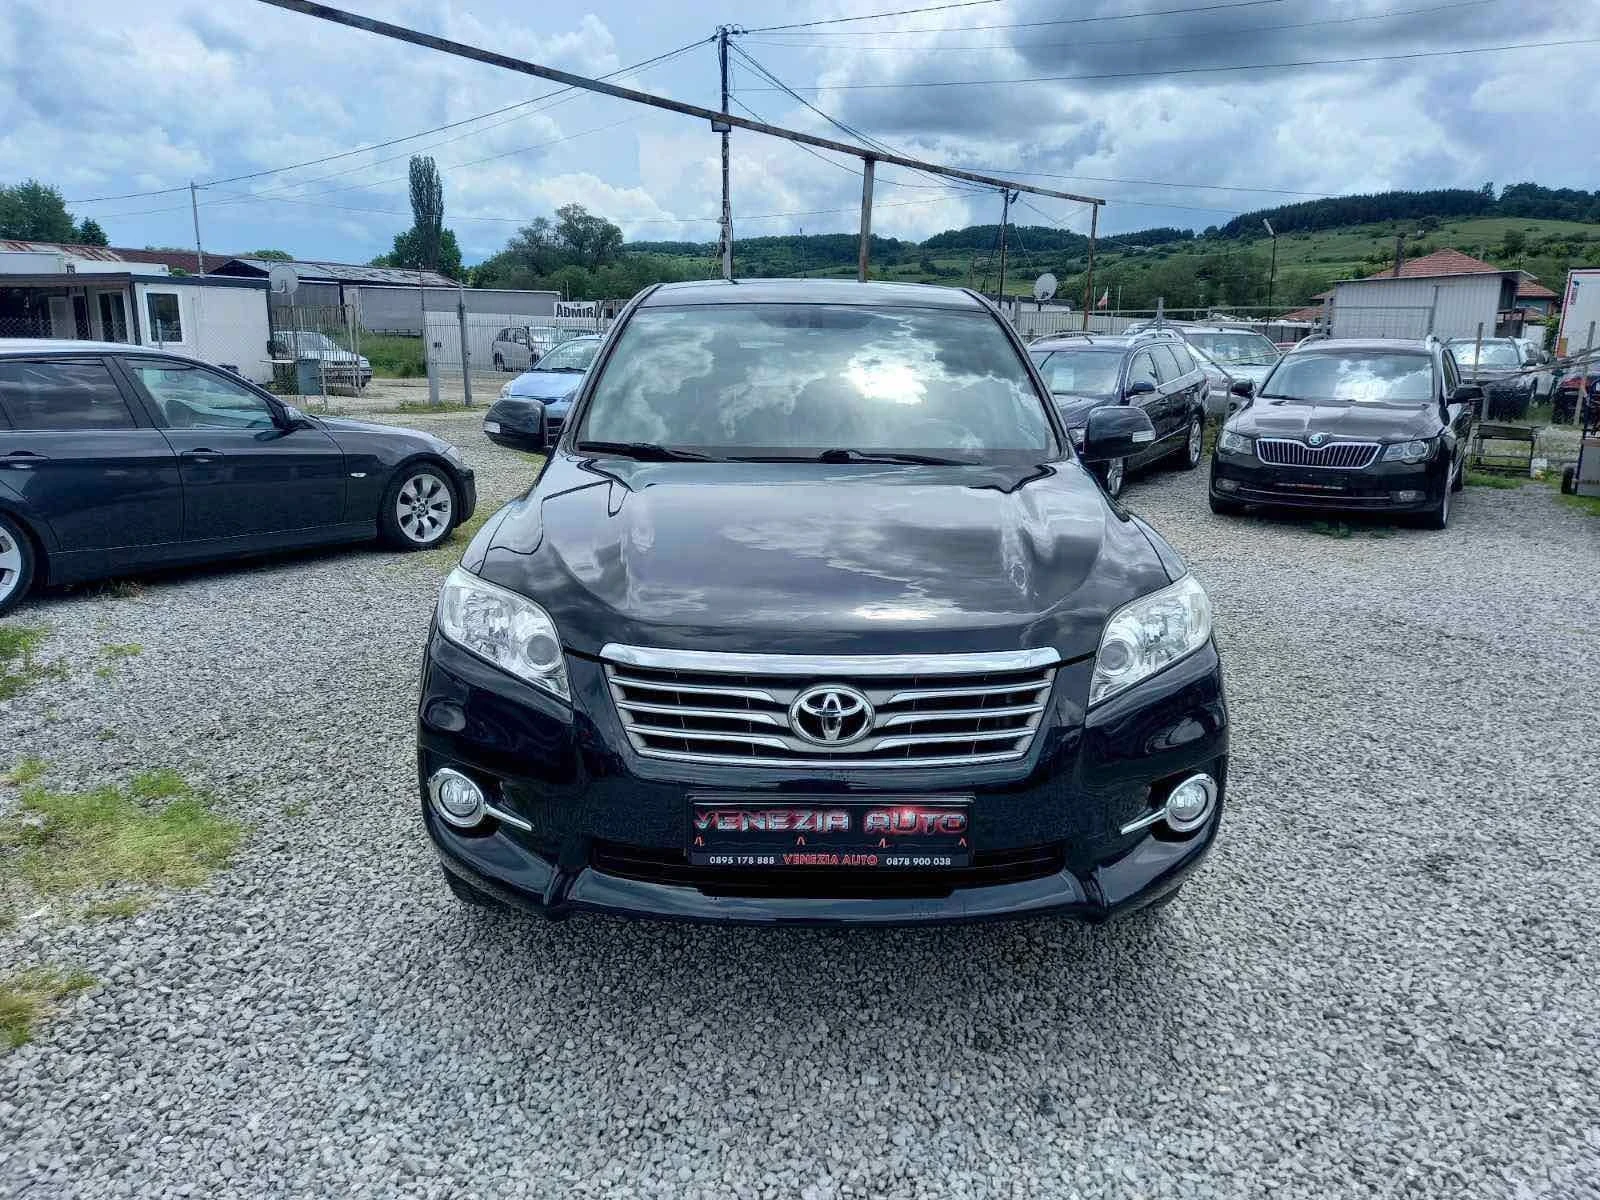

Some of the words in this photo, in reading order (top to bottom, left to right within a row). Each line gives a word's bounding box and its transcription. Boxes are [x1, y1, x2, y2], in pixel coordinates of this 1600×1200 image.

[694, 808, 849, 832] VENEZIA
[864, 809, 967, 834] AUTO
[709, 856, 734, 865] 0895
[737, 856, 754, 865] 178
[757, 856, 775, 865] 888
[783, 853, 838, 865] VENEZIA
[842, 854, 878, 865] AUTO
[886, 857, 910, 866] 0878
[913, 857, 931, 866] 900
[933, 857, 951, 866] 038
